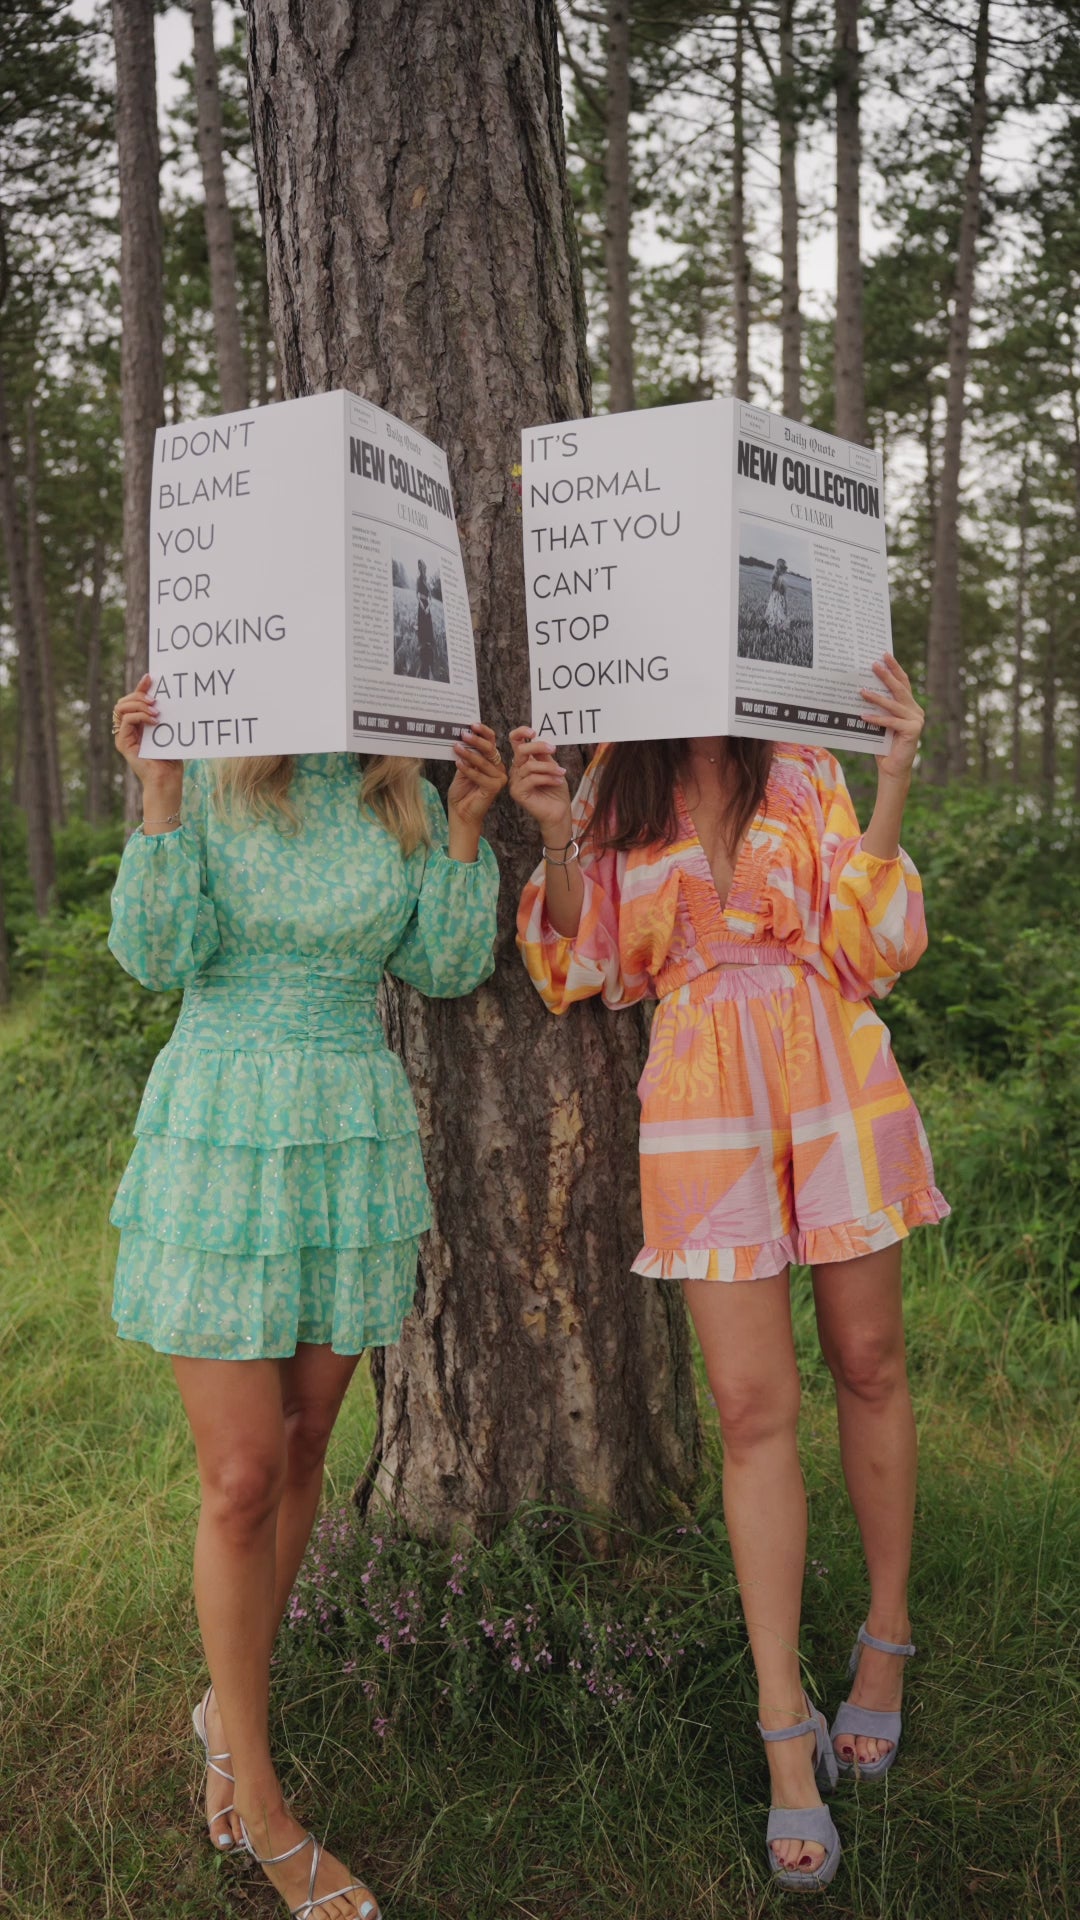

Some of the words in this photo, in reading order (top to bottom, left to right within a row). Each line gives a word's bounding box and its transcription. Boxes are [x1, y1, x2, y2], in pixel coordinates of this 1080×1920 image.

[530, 432, 579, 463] IT'S
[784, 427, 807, 449] Daily
[809, 438, 836, 458] Quote
[159, 469, 251, 510] BLAME
[350, 436, 385, 485] NEW
[388, 453, 453, 520] COLLECTION
[530, 467, 661, 509] NORMAL
[737, 439, 778, 486] NEW
[783, 456, 880, 520] COLLECTION
[157, 523, 215, 557] YOU
[530, 519, 609, 553] THAT
[612, 510, 681, 542] YOU
[157, 573, 211, 605] FOR
[532, 564, 618, 600] CAN'T
[155, 613, 287, 653] LOOKING
[534, 613, 610, 646] STOP
[154, 672, 189, 700] AT
[194, 668, 236, 697] MY
[537, 655, 669, 692] LOOKING
[538, 710, 574, 737] AT
[578, 708, 602, 735] IT
[742, 702, 753, 713] YOU
[753, 703, 764, 714] GOT
[765, 704, 779, 716] THIS!
[797, 709, 808, 720] YOU
[807, 711, 817, 721] GOT
[846, 717, 857, 728] YOU
[152, 716, 259, 748] OUTFIT
